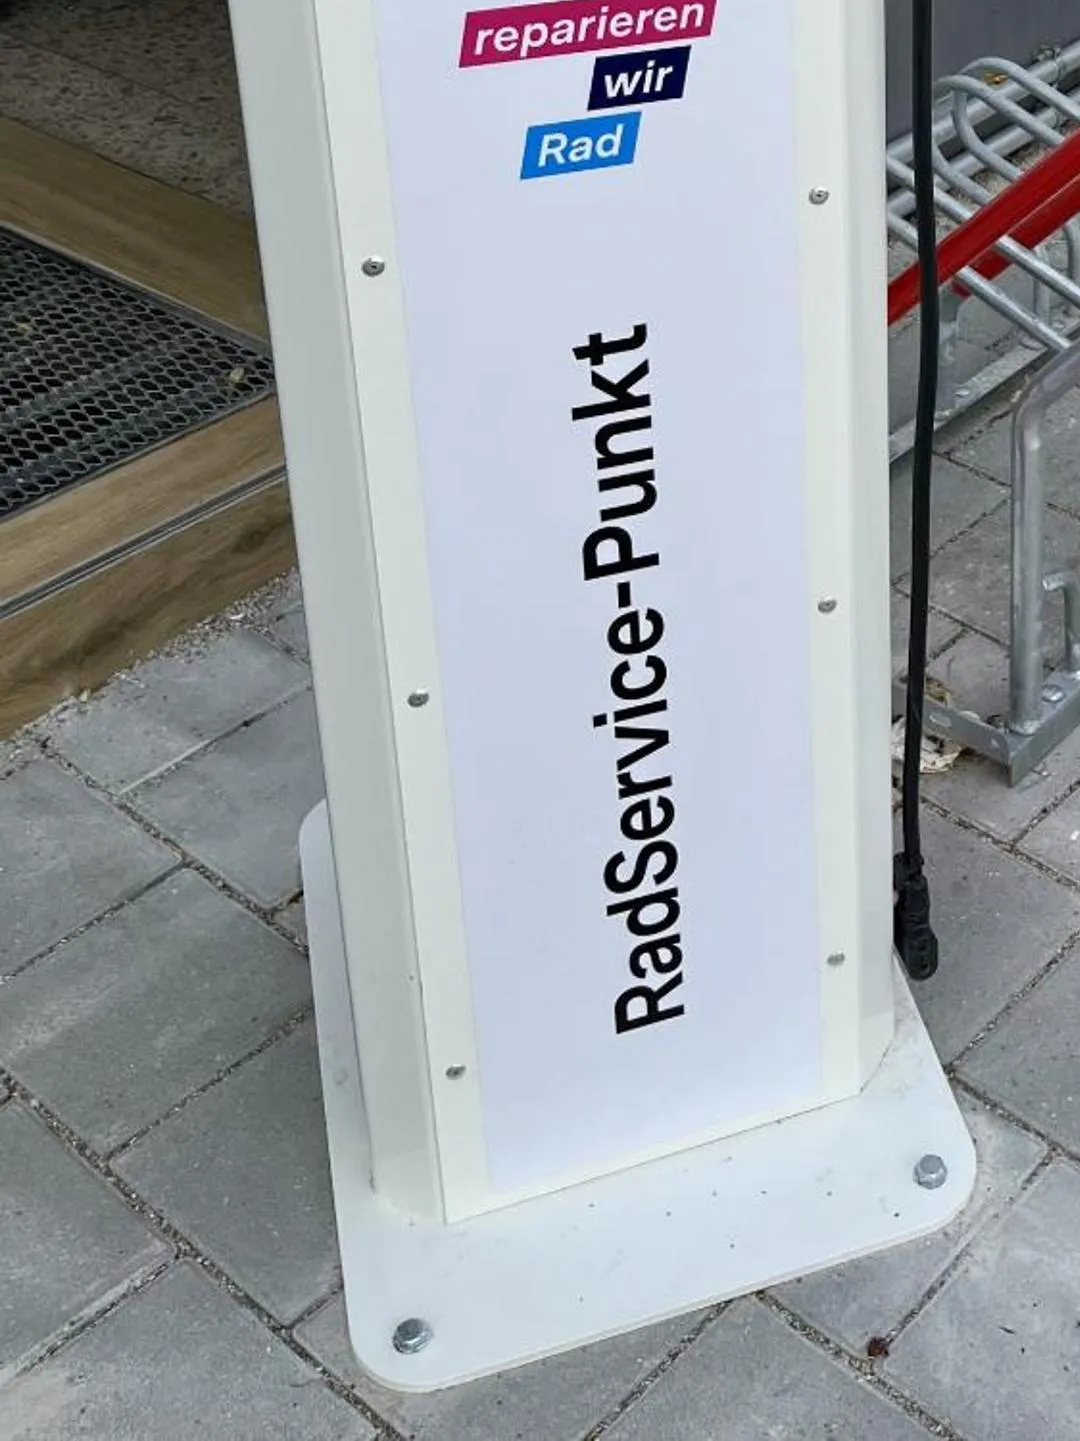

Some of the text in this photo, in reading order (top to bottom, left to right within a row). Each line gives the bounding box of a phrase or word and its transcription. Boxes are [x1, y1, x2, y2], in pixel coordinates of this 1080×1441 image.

[474, 2, 704, 58] reparieren
[603, 60, 674, 98] wir
[537, 123, 625, 168] Rad
[571, 323, 685, 1035] RadService-Punkt
